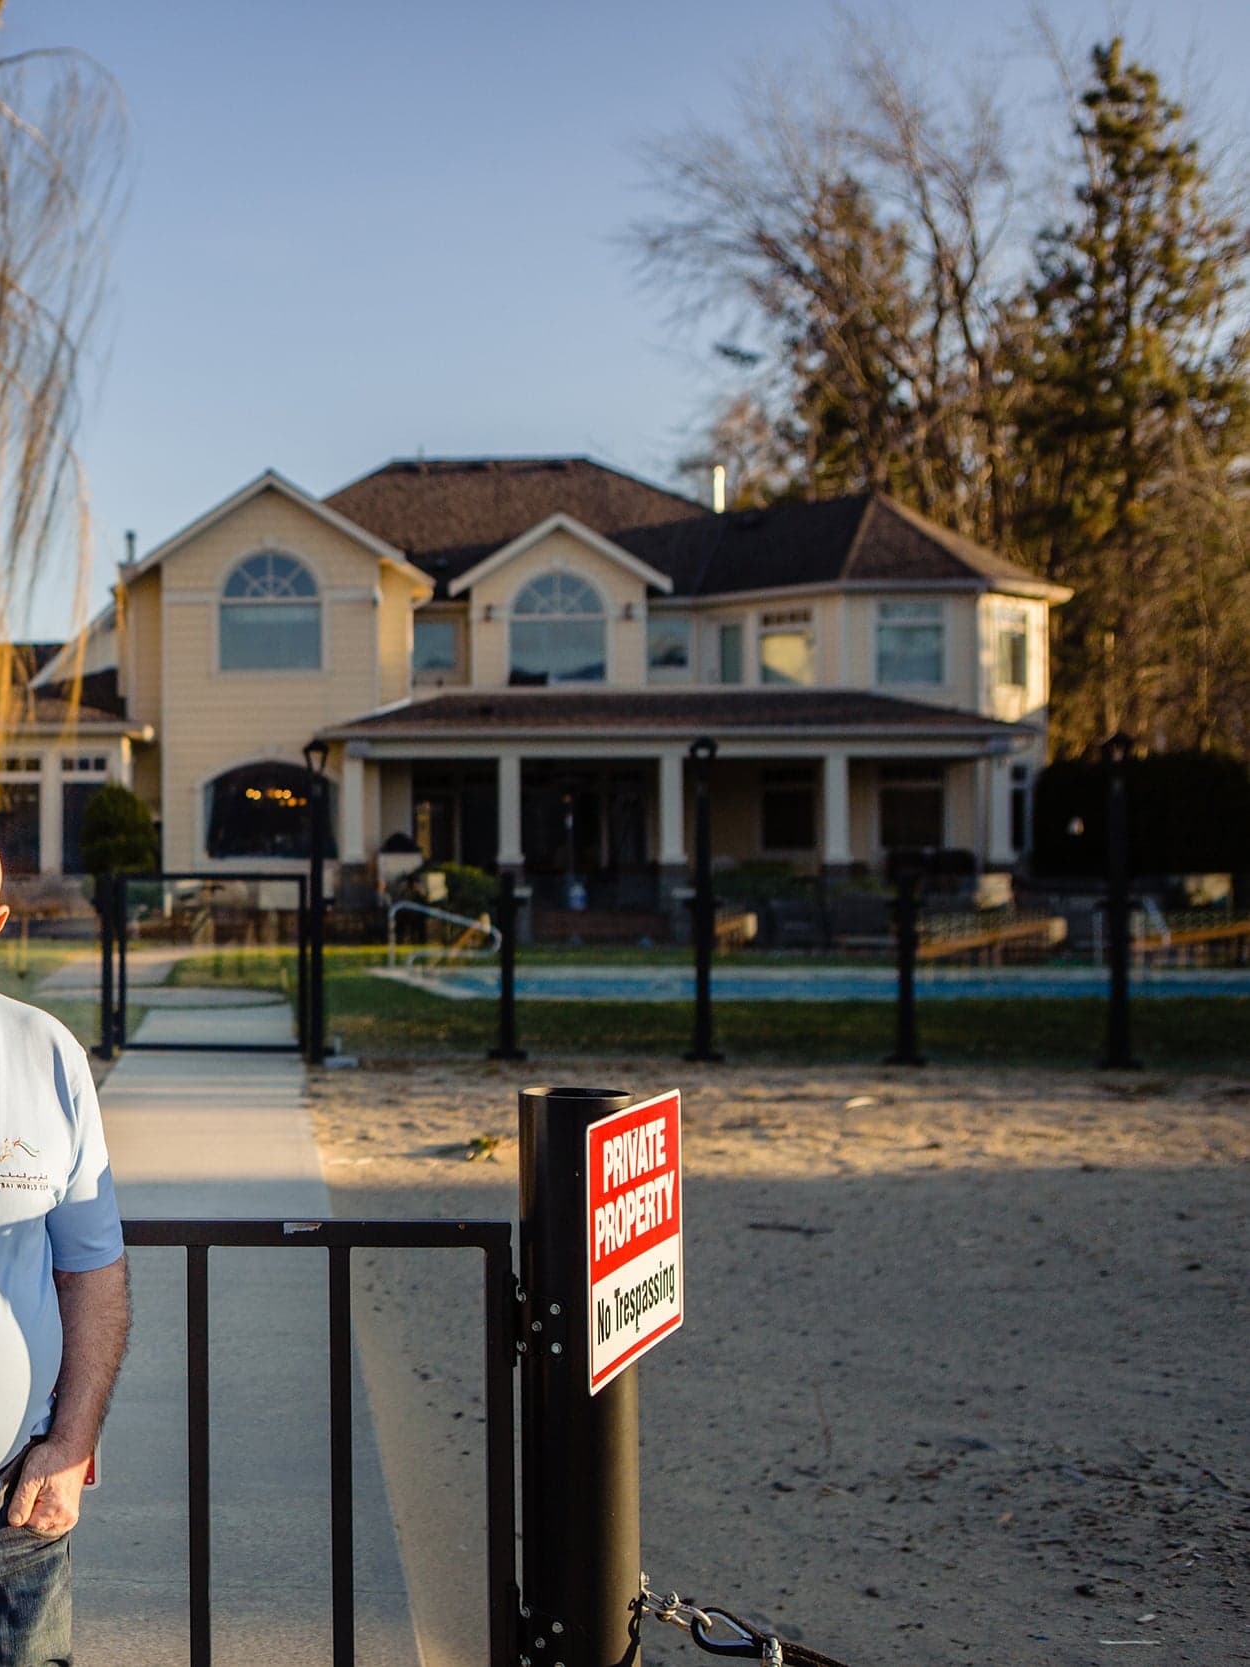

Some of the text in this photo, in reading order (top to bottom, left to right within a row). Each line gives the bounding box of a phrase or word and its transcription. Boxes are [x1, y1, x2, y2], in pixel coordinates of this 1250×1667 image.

[603, 1117, 666, 1193] PRIVATE
[594, 1170, 675, 1262] PROPERTY
[597, 1261, 675, 1345] No Trespassing
